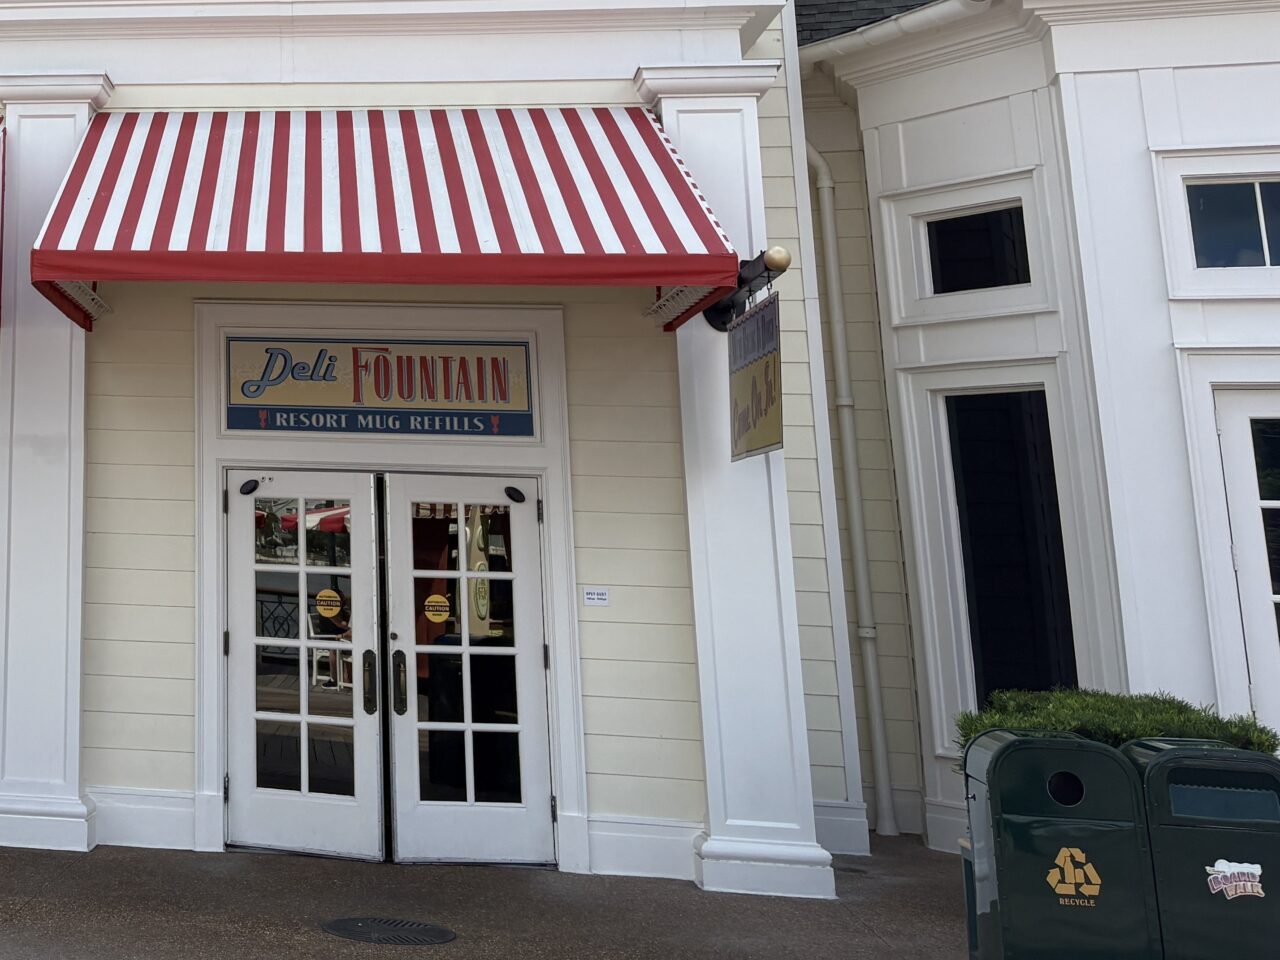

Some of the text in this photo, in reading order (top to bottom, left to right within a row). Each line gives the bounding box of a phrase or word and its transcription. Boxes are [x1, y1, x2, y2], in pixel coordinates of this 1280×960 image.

[241, 346, 511, 406] Deli FOUNTAIN
[275, 411, 485, 432] RESORT MUG REFILLS
[1059, 897, 1097, 908] RECYCLE
